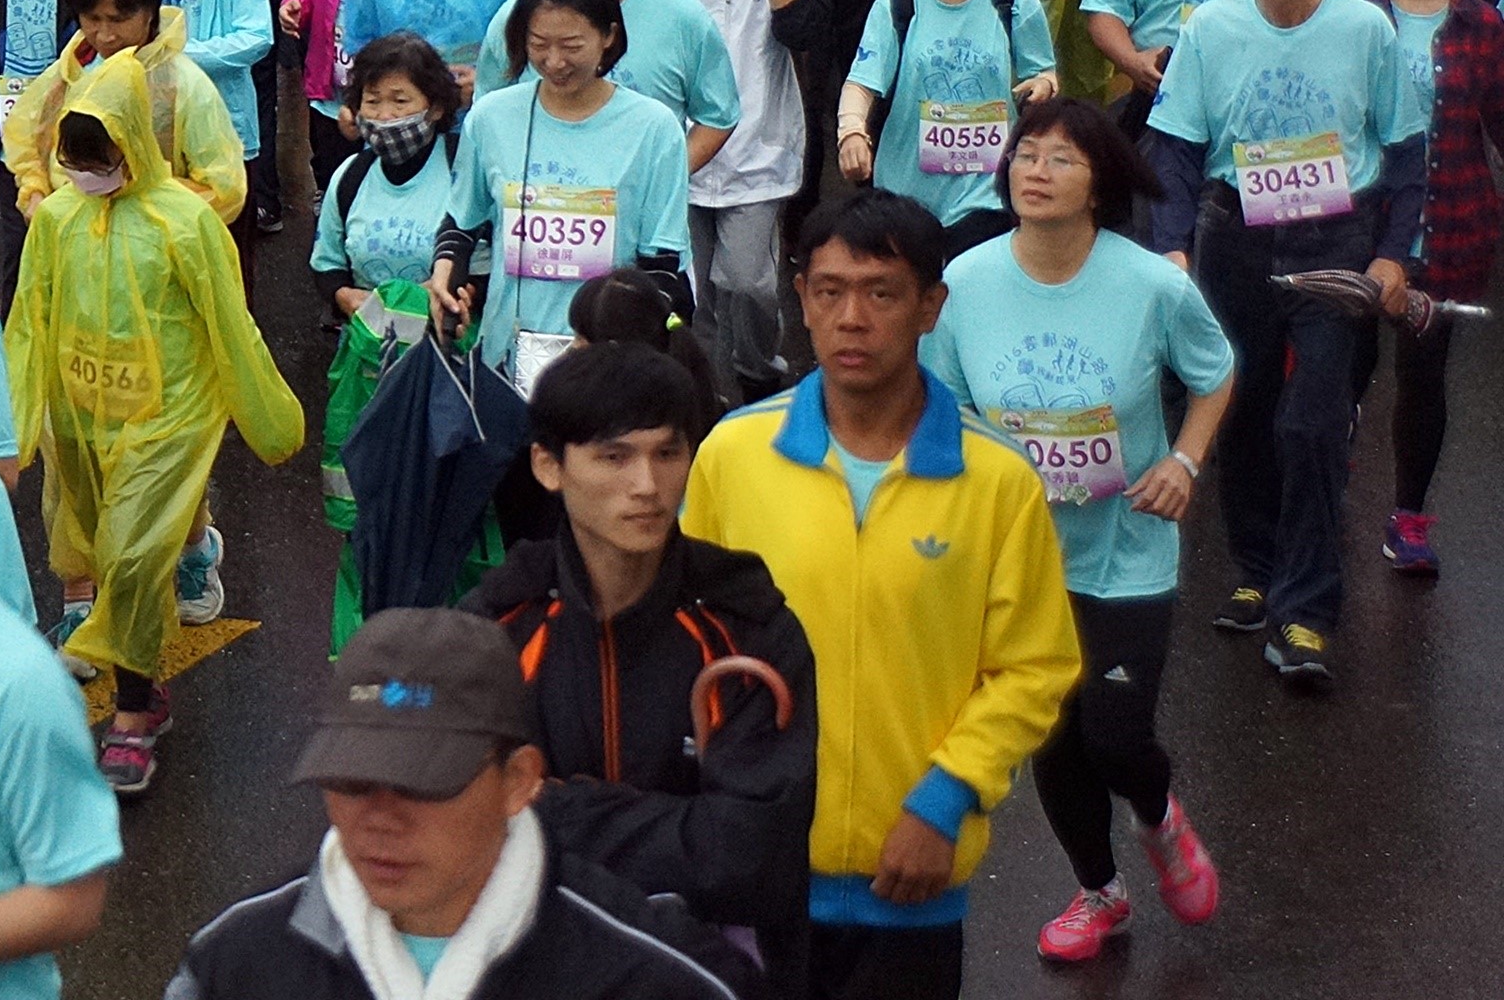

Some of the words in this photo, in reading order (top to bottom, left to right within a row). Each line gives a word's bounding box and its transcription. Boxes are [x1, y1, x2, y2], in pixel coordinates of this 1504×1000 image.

[925, 126, 1001, 148] 40556
[1246, 160, 1335, 195] 30431
[511, 215, 606, 246] 40359
